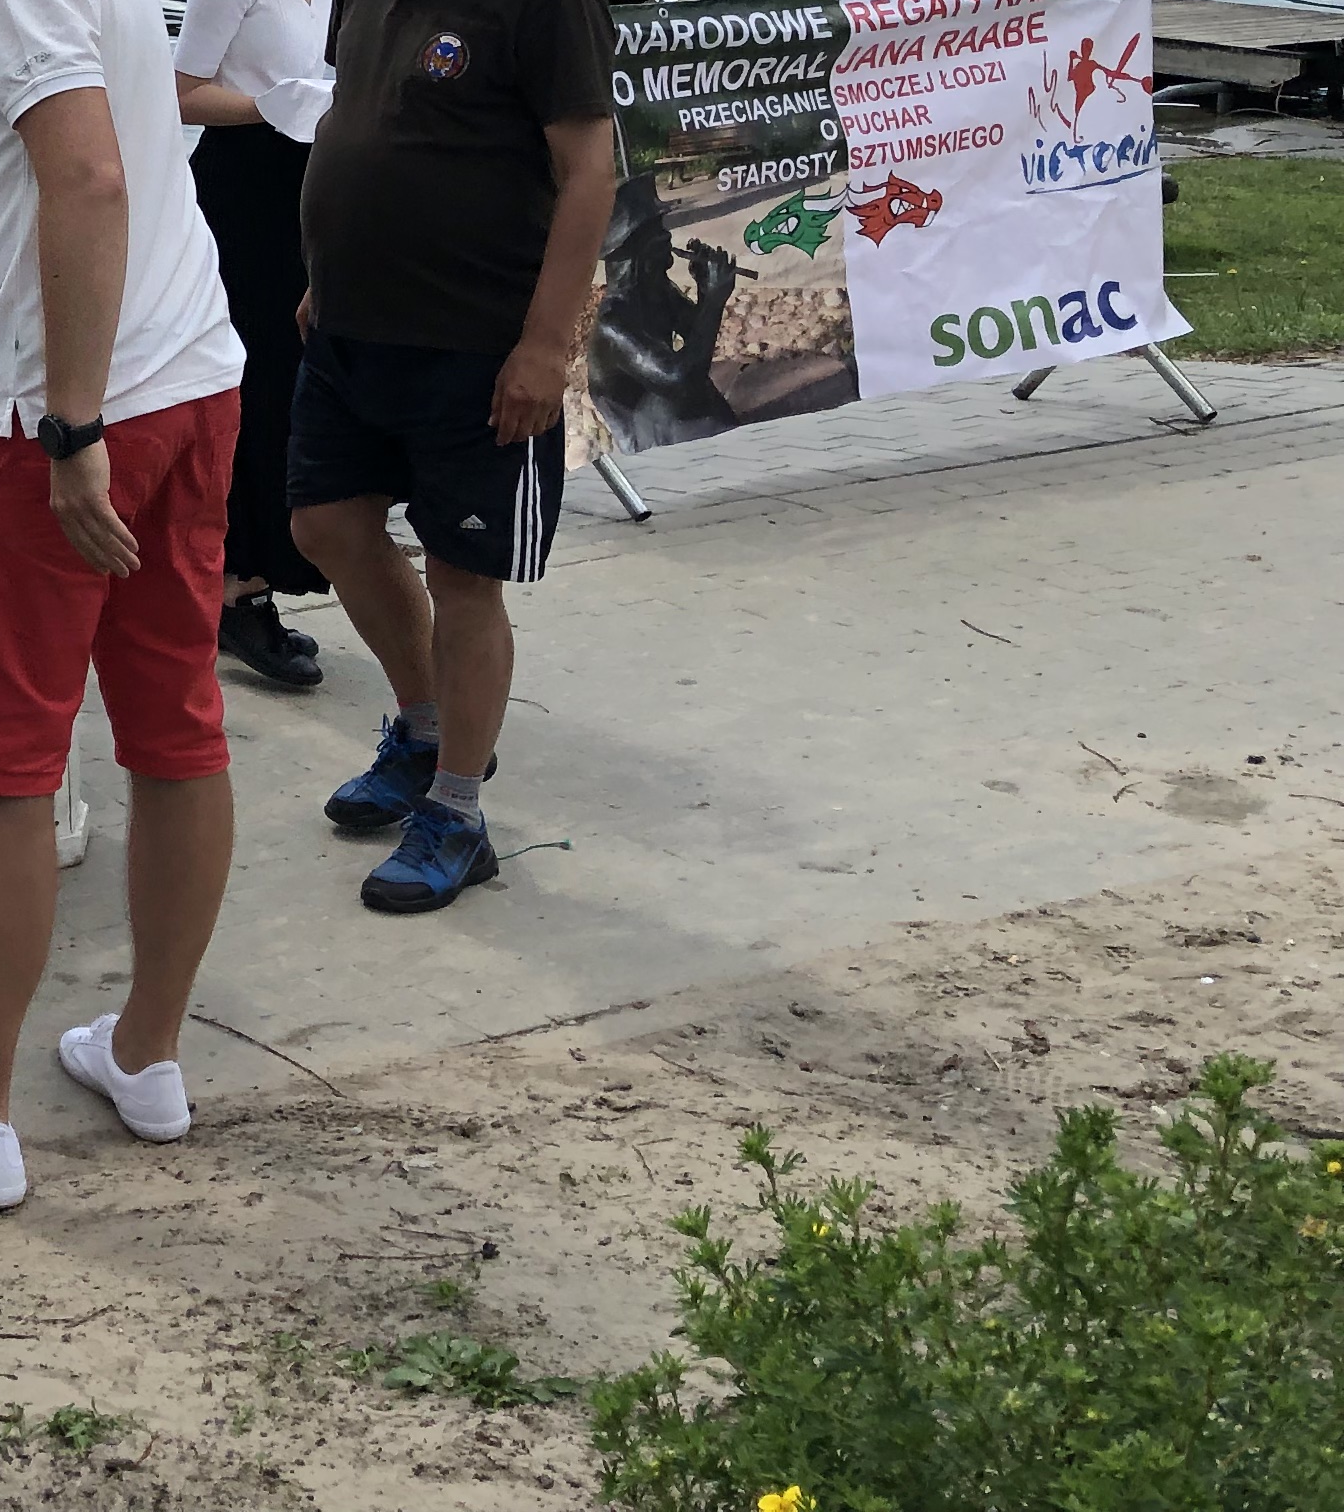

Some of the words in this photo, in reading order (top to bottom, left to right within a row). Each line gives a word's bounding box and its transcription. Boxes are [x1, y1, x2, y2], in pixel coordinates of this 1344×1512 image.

[615, 6, 833, 55] NARODOWE
[644, 52, 827, 101] MEMORIAŁ
[836, 29, 928, 74] JANA
[934, 10, 1049, 60] RAABE
[679, 88, 832, 131] PRZECIĄGANIE
[835, 71, 934, 107] SMOCZEJ
[940, 61, 1007, 91] ŁODZI
[820, 120, 838, 140] O
[842, 104, 931, 138] PUCHAR
[717, 150, 838, 191] STAROSTY
[850, 124, 1005, 169] SZTUMSKIEGO
[930, 281, 1137, 366] sonac
